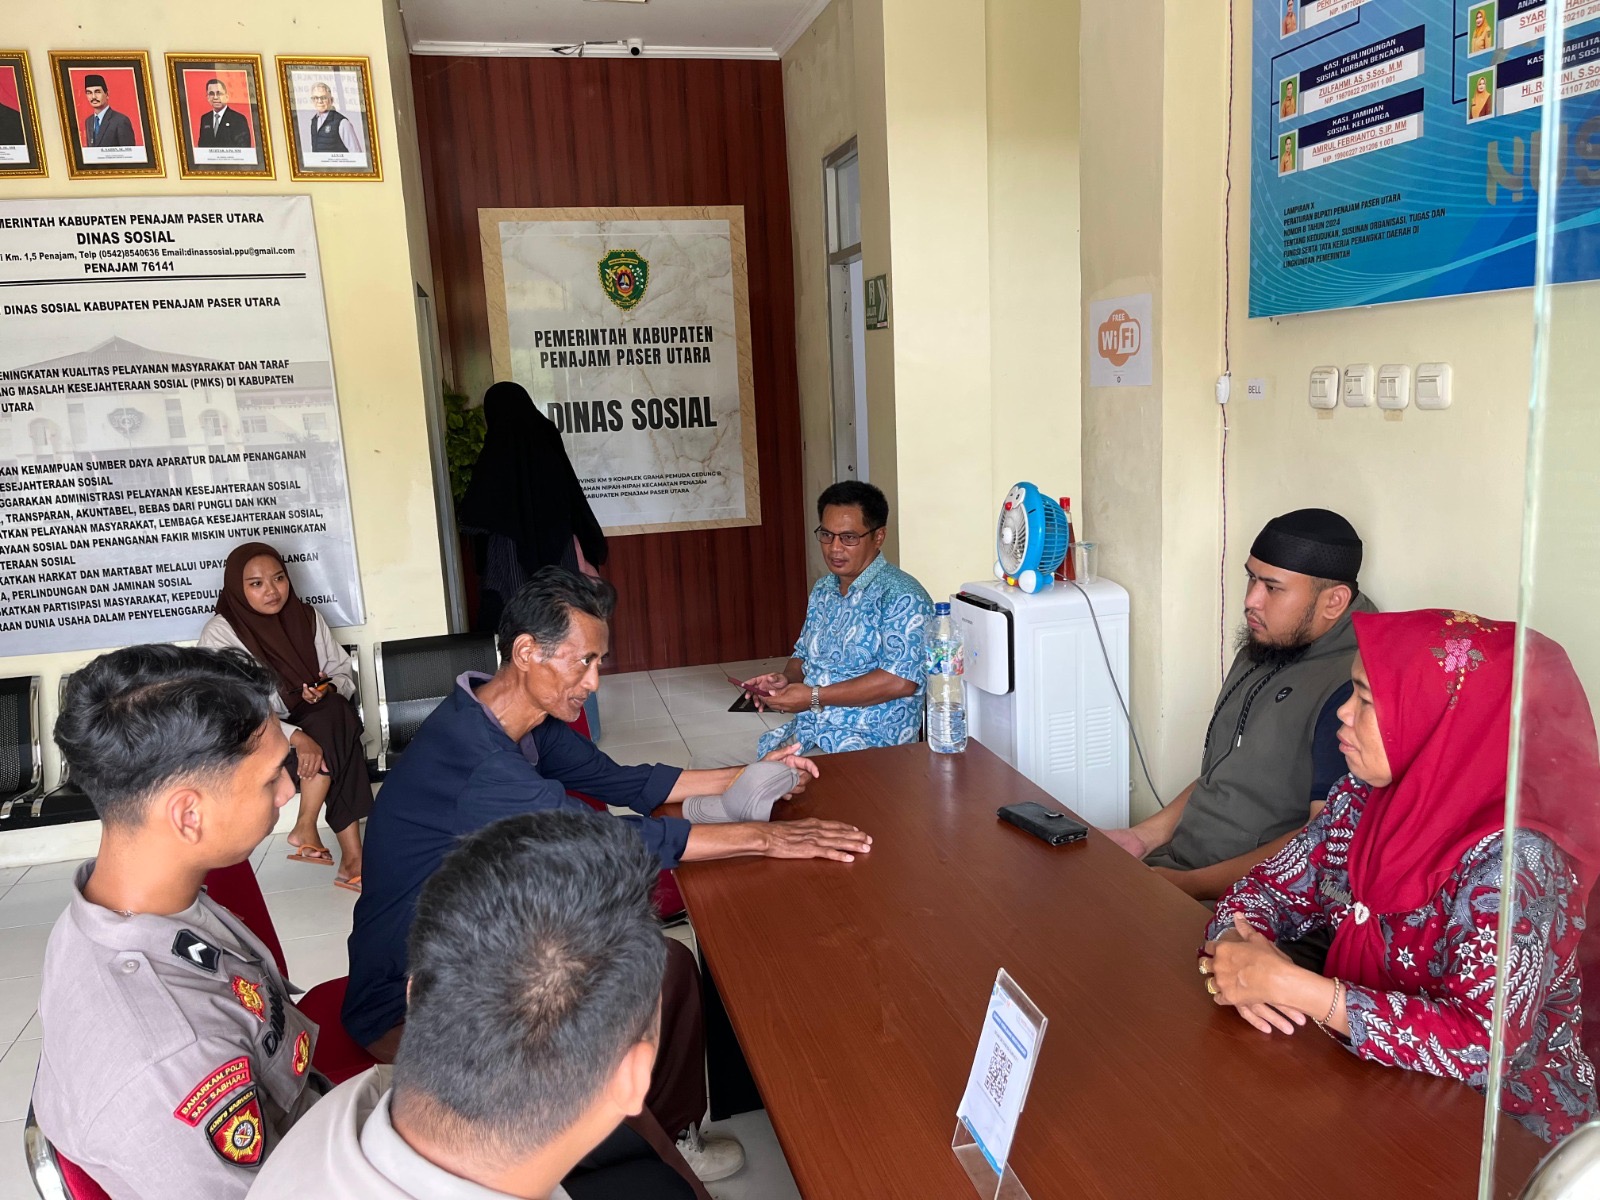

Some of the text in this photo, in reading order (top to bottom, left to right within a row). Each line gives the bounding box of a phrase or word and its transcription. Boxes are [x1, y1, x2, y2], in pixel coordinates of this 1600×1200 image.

[1342, 39, 1396, 64] PERLINDUNGAN
[1316, 45, 1405, 84] SOSIAL KORBAN BENCANA
[1352, 105, 1384, 120] JAMINAN
[1326, 112, 1390, 137] SOSIAL KELUARGA
[1312, 143, 1336, 155] AMIRUL
[1394, 120, 1407, 130] MM
[58, 215, 127, 227] KABUPATEN
[129, 214, 184, 225] PENAJAM
[187, 213, 224, 224] PASER
[226, 212, 264, 223] UTARA
[1283, 193, 1401, 226] PERATURAN BUPATI PENAJAM PASER UTARA
[1283, 204, 1310, 216] LAMPIRAN
[1283, 237, 1306, 247] TENTANG
[1341, 224, 1369, 236] SUSUNAN
[1409, 211, 1430, 223] TUGAS
[1431, 208, 1446, 218] DAN
[1307, 222, 1325, 231] TAHUN
[1325, 218, 1341, 229] 2024
[76, 230, 176, 245] DINAS SOSIAL
[1301, 245, 1318, 255] SERTA
[1319, 242, 1332, 251] TATA
[1332, 239, 1350, 249] KERJA
[1351, 231, 1385, 245] PERANGKAT
[1386, 227, 1411, 239] DAERAH
[1412, 225, 1420, 234] DI
[5, 246, 296, 262] Km. 1,5 Penajam, Telp (0542)8540636 Email:dinassosial.ppu@gmail.com
[1315, 250, 1350, 263] PEMERINTAH
[84, 261, 175, 273] PENAJAM 76141
[4, 296, 281, 315] DINAS SOSIAL KABUPATEN PENAJAM PASER UTARA
[1112, 313, 1125, 322] FREE
[534, 325, 714, 348] PEMERINTAH KABUPATEN
[62, 359, 290, 378] KUALITAS PELAYANAN MASYARAKAT DAN TARAF
[540, 346, 711, 369] PENAJAM PASER UTARA
[18, 384, 65, 396] MASALAH
[67, 380, 151, 393] KESEJAHTERAAN
[153, 379, 188, 389] SOSIAL
[191, 377, 224, 389] (PMKS)
[226, 377, 236, 386] DI
[239, 374, 294, 386] KABUPATEN
[1248, 385, 1262, 395] BELL
[1, 401, 35, 413] UTARA
[547, 396, 718, 434] DINAS SOSIAL
[21, 450, 307, 475] KEMAMPUAN SUMBER DAYA APARATUR DALAM PENANGANAN
[55, 480, 301, 504] ADMINISTRASI PELAYANAN KESEJAHTERAAN SOSIAL
[78, 476, 113, 487] SOSIAL
[601, 483, 641, 491] NIPAH-NIPAH
[641, 480, 678, 488] KECAMATAN
[6, 496, 277, 523] TRANSPARAN, AKUNTABEL, BEBAS DARI PUNGLI DAN KKN
[31, 509, 324, 537] PELAYANAN MASYARAKAT, LEMBAGA KESEJAHTERAAN SOSIAL,
[32, 522, 327, 552] SOSIAL DAN PENANGANAN FAKIR MISKIN UNTUK PENINGKATAN
[38, 570, 77, 583] HARKAT
[80, 568, 100, 579] DAN
[102, 565, 153, 578] MARTABAT
[155, 561, 197, 573] MELALUI
[41, 556, 76, 567] SOSIAL
[12, 585, 88, 599] PERLINDUNGAN
[90, 583, 110, 594] DAN
[112, 580, 156, 592] JAMINAN
[158, 577, 192, 588] SOSIAL
[43, 599, 101, 612] PARTISIPASI
[103, 593, 170, 607] MASYARAKAT,
[305, 594, 338, 605] SOSIAL
[25, 618, 55, 630] DUNIA
[58, 615, 91, 627] USAHA
[93, 612, 126, 623] DALAM
[180, 1060, 245, 1116] BAHARKAM POLRI
[190, 1072, 246, 1119] SAT SABHARA
